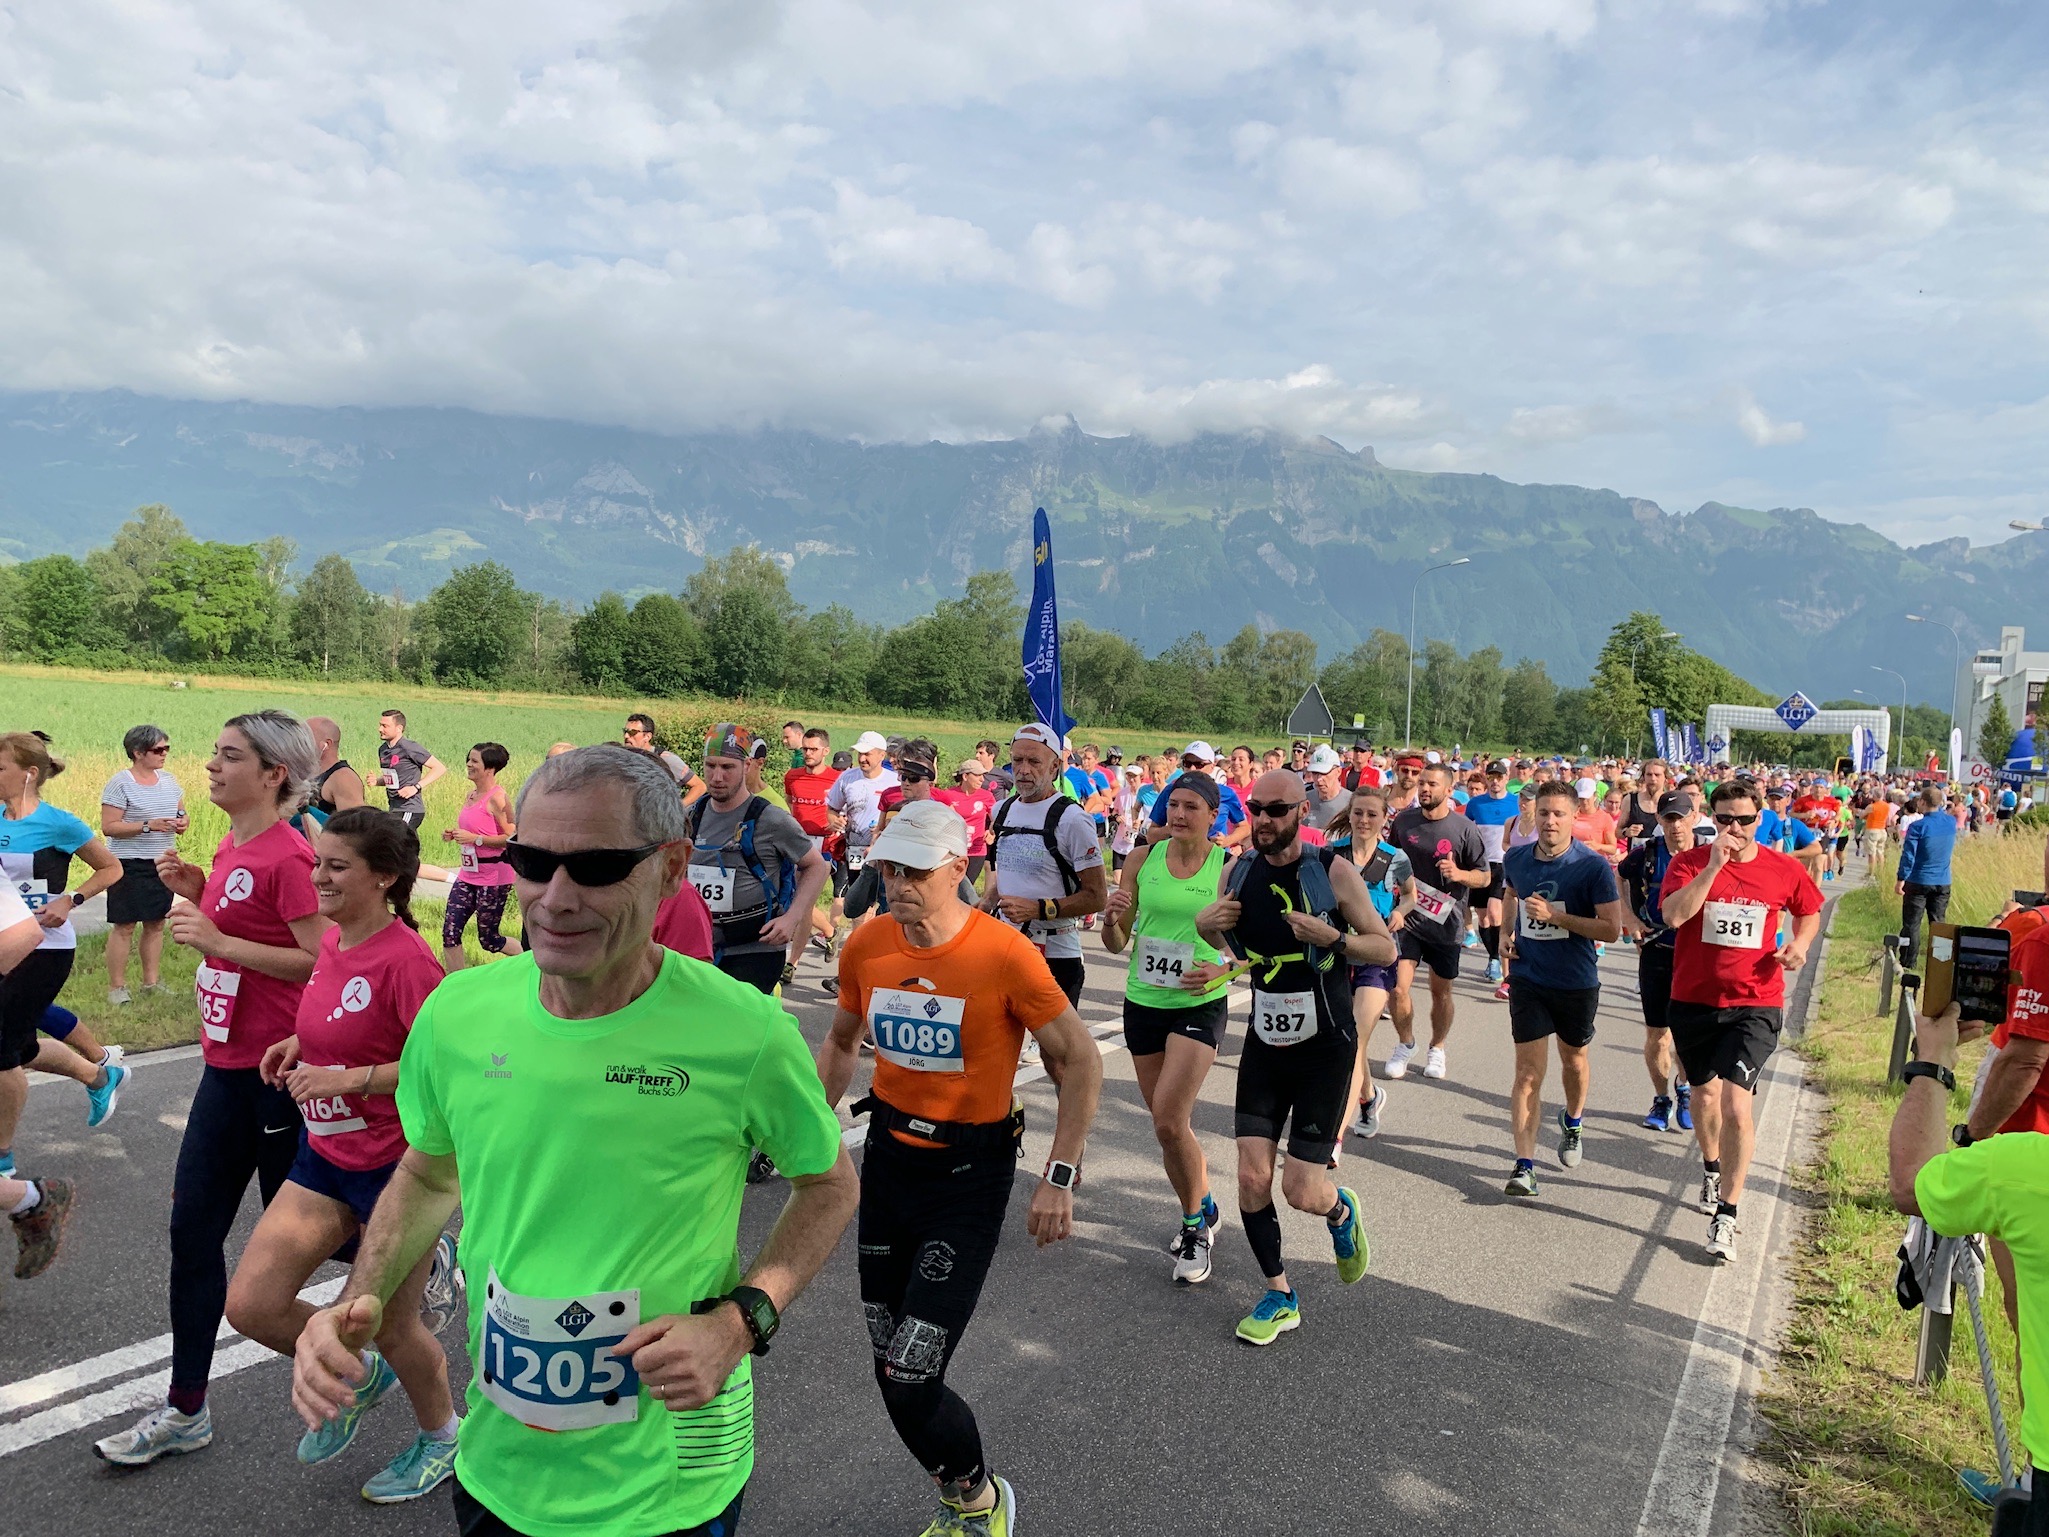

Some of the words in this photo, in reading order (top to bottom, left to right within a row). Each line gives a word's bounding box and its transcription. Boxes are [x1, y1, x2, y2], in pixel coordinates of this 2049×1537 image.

[1782, 707, 1810, 720] LGT
[1731, 896, 1749, 905] LGT
[1715, 919, 1753, 937] 381
[1145, 955, 1183, 977] 344
[923, 1003, 940, 1013] LGT
[1263, 1012, 1306, 1033] 387
[880, 1020, 955, 1055] 1089
[908, 1057, 925, 1068] JÖRG
[484, 1068, 512, 1079] erima
[606, 1065, 619, 1073] run
[620, 1064, 626, 1073] &
[627, 1065, 647, 1075] walk
[605, 1072, 674, 1087] LAUF-TREFF
[638, 1085, 661, 1096] Buchs
[662, 1087, 676, 1097] SG
[513, 1314, 530, 1324] Alpin
[561, 1312, 590, 1327] LGT
[490, 1332, 626, 1398] 1205
